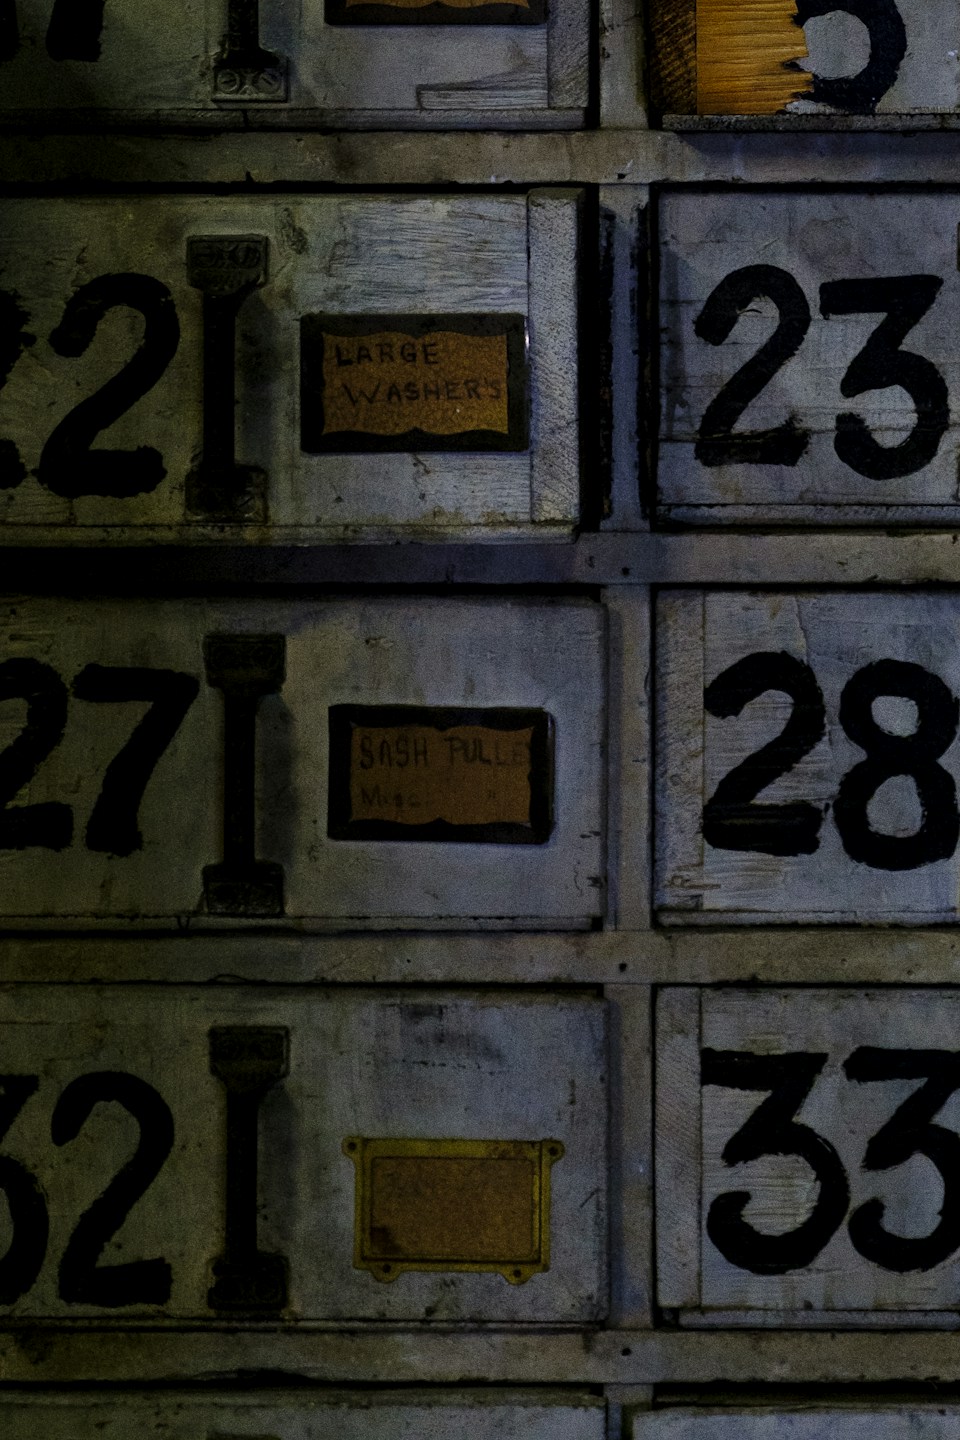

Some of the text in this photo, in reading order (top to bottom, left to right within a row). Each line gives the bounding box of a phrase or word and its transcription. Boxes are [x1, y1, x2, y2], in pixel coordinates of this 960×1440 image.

[335, 343, 440, 367] LARGE
[693, 264, 910, 480] 23
[359, 734, 430, 770] SASH
[702, 651, 960, 870] 28
